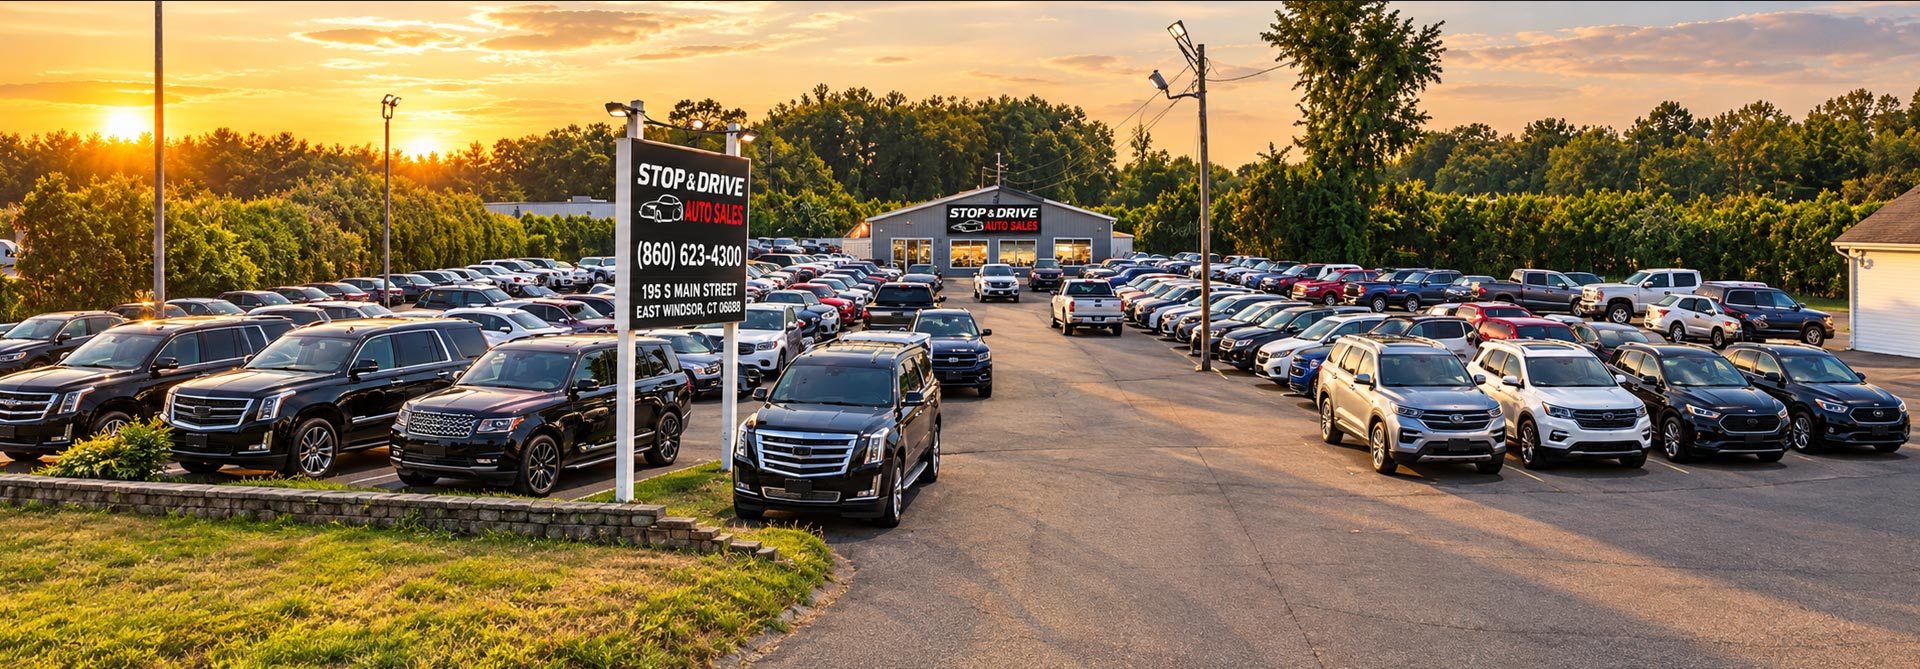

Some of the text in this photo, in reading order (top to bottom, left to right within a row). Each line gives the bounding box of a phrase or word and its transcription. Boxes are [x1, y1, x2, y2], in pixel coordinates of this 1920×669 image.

[638, 163, 686, 189] STOP
[686, 173, 696, 191] &
[685, 200, 744, 225] AUTO SALES
[949, 207, 1039, 218] STOP & DRIVE
[984, 220, 1038, 231] AUTO SALES
[637, 240, 741, 270] (860) 623-4300
[642, 282, 738, 299] 195 S MAIN STREET
[636, 304, 661, 319] EAST
[662, 302, 706, 317] WINDSOR,
[706, 302, 718, 315] CT
